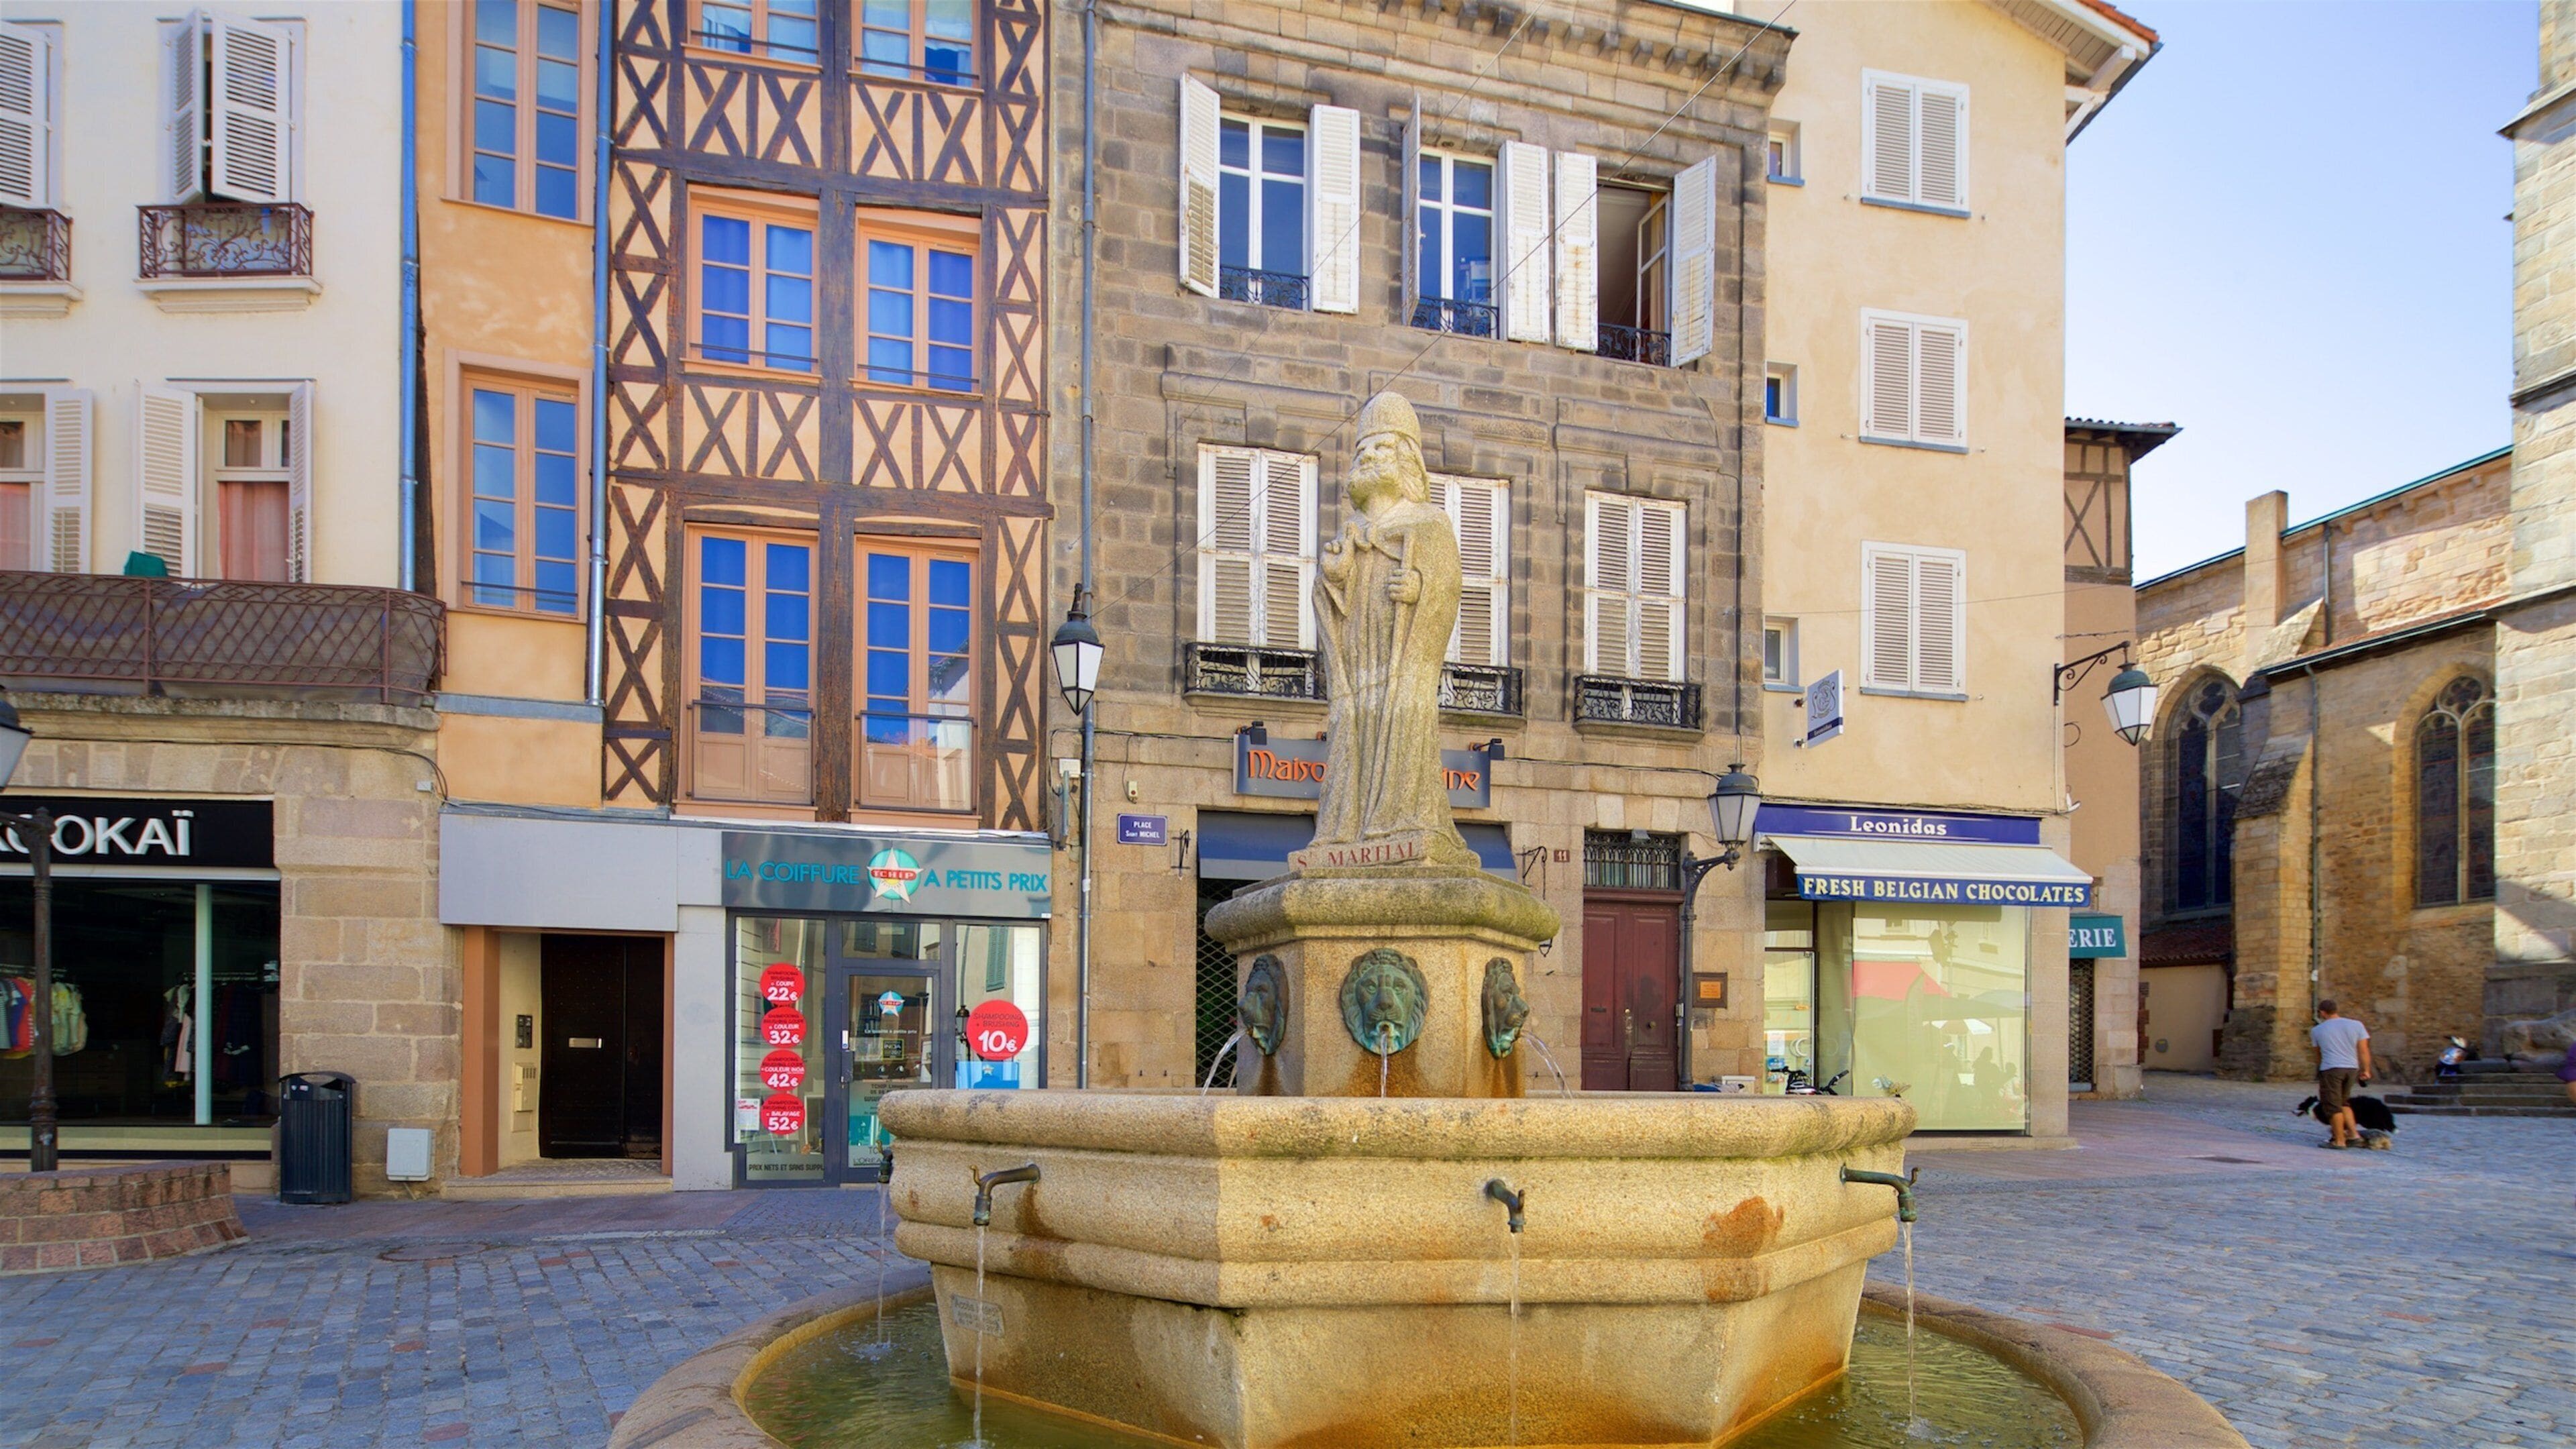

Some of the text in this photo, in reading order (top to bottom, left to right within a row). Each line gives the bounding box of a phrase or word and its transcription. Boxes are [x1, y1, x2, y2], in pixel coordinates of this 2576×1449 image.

[1248, 749, 1480, 791] Maiso ine
[1133, 821, 1152, 829] PLACE
[1850, 815, 1947, 836] Leonidas
[1328, 842, 1413, 866] MARTIAL
[1558, 851, 1568, 861] 11
[726, 860, 1048, 893] LA COIFFURE A PETITS PRIX
[873, 870, 914, 879] TCHIP
[1804, 877, 2085, 904] FRESH BELGIAN CHOCOLATES
[2070, 928, 2116, 948] ERIE
[767, 986, 798, 1001] 22€
[769, 1030, 800, 1044] 32€
[767, 1073, 798, 1087] 42€
[768, 1117, 798, 1131] 52€
